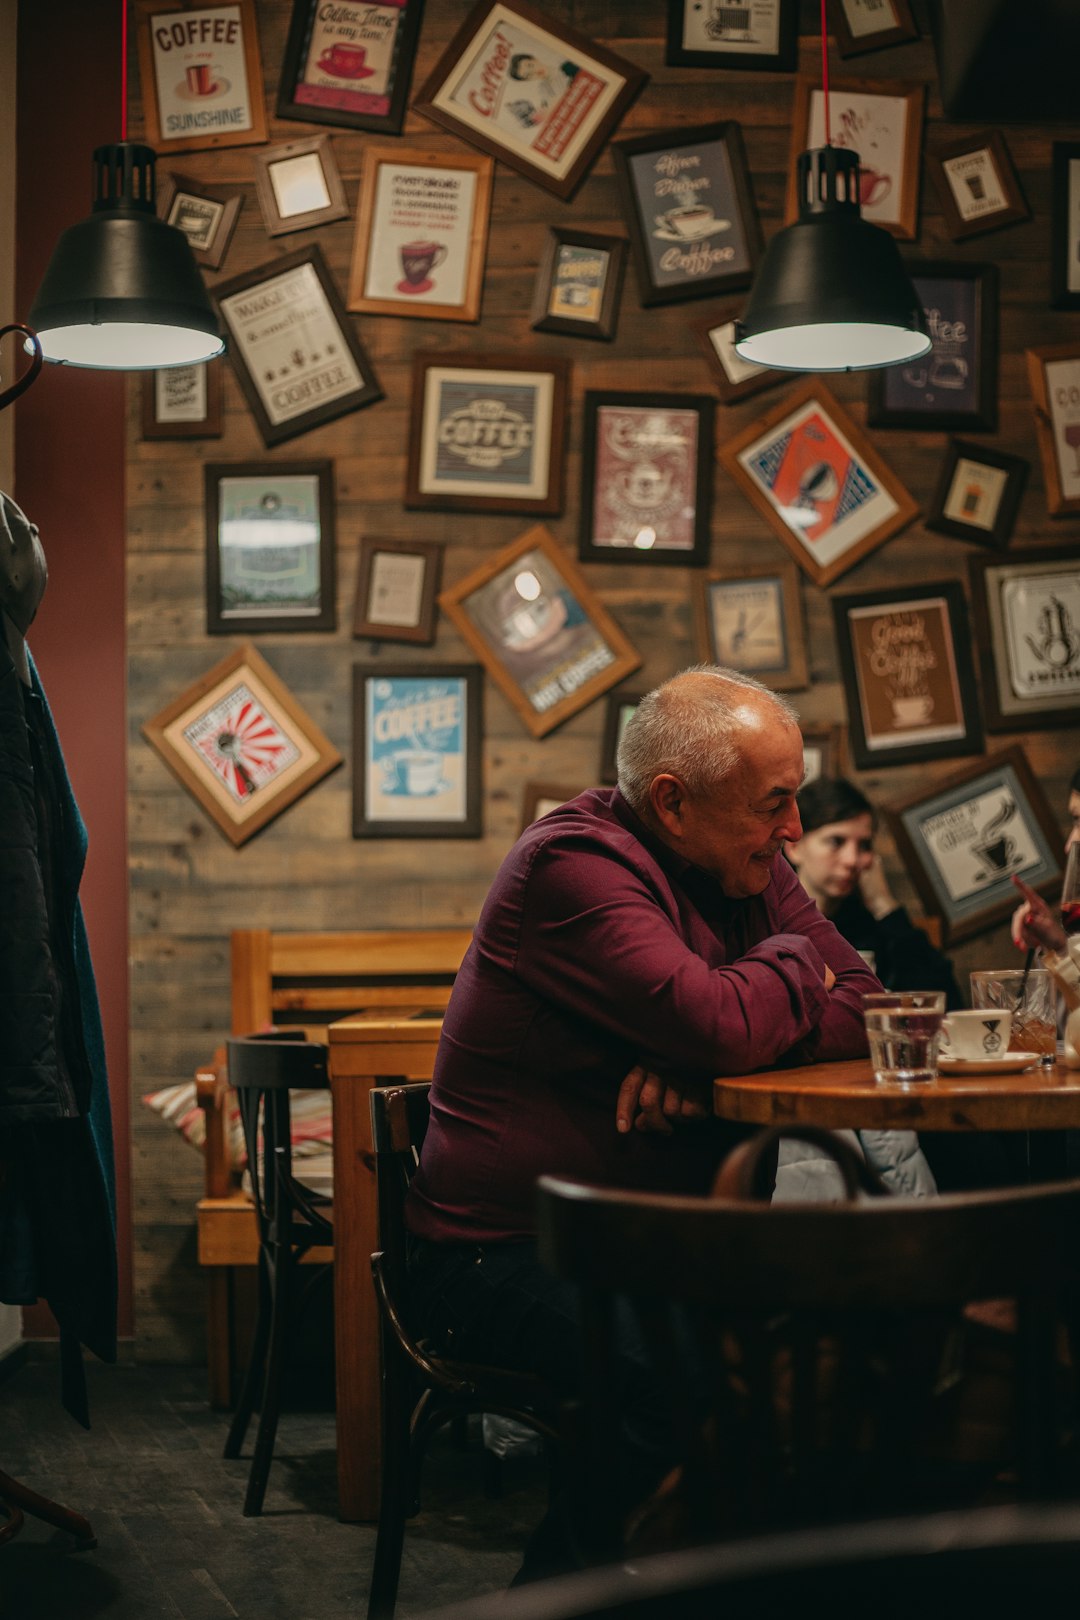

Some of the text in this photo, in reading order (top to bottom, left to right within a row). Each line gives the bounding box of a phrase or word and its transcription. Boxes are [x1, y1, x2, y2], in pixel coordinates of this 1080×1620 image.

[318, 3, 395, 28] Coffee Time
[155, 18, 239, 52] COFFEE
[334, 26, 358, 40] any
[470, 33, 514, 118] Coffee!
[167, 106, 245, 133] SUNSHINE
[660, 241, 736, 276] Coffee
[271, 365, 348, 410] COFFEE
[438, 418, 533, 449] COFFEE
[374, 694, 460, 744] COFFEE
